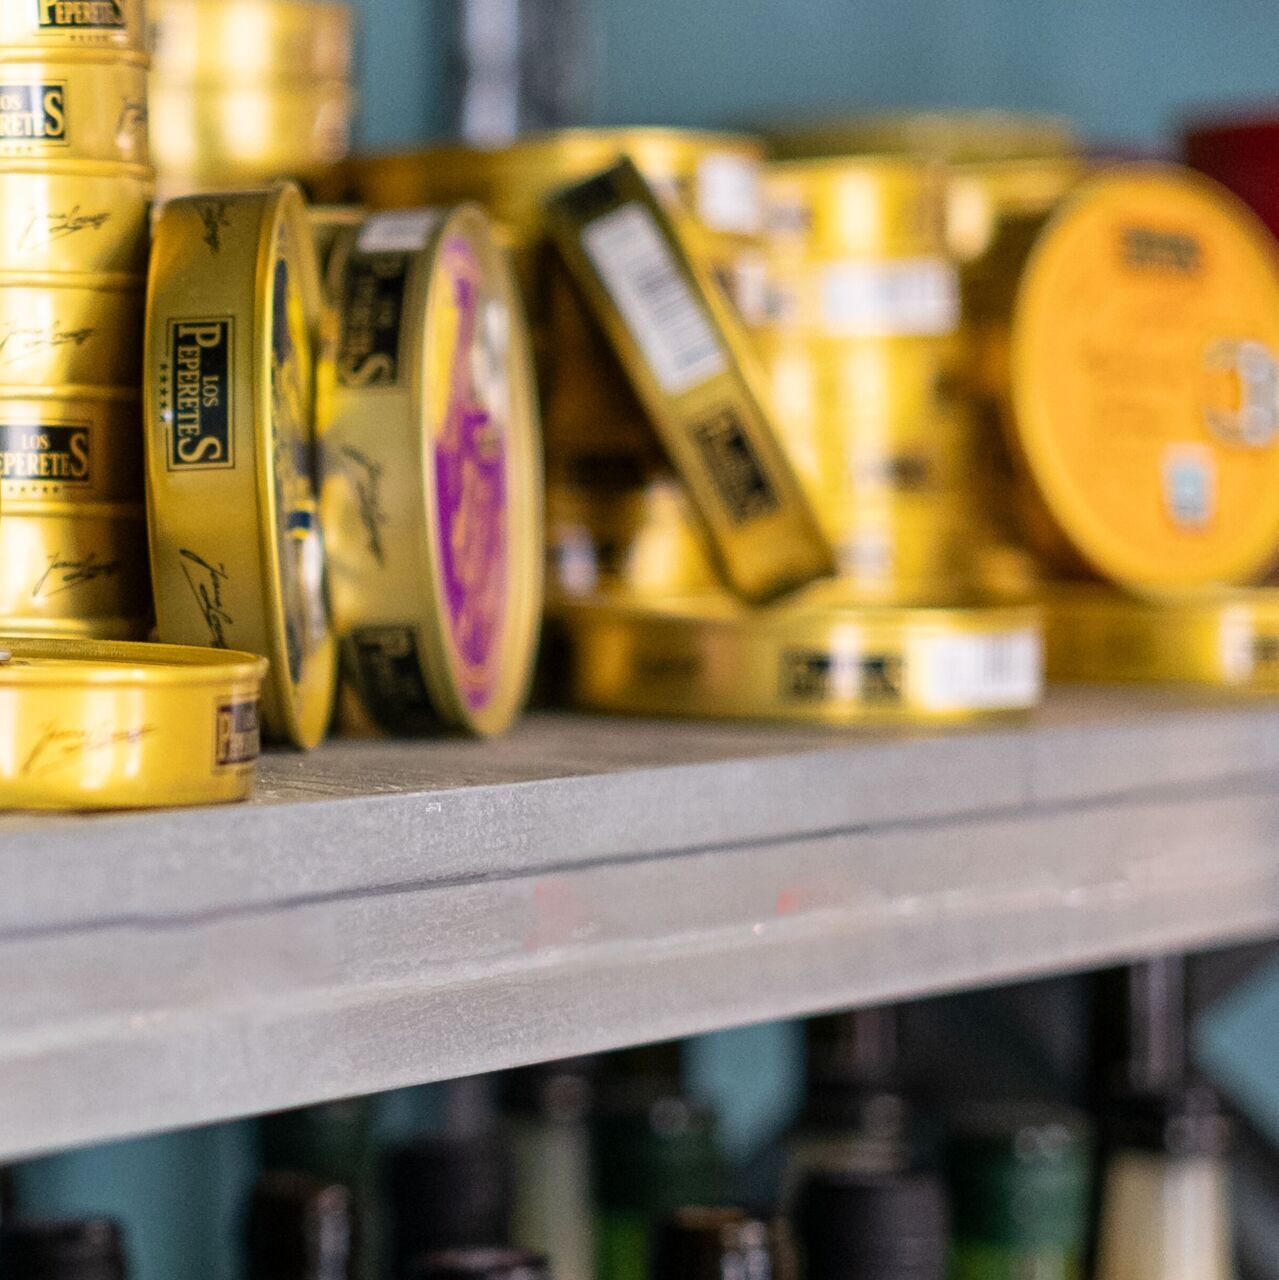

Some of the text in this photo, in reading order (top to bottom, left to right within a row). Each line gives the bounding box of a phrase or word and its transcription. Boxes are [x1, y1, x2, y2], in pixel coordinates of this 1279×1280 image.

[177, 323, 221, 464] PEPERETES
[202, 374, 220, 408] LOS
[20, 434, 49, 451] LOS
